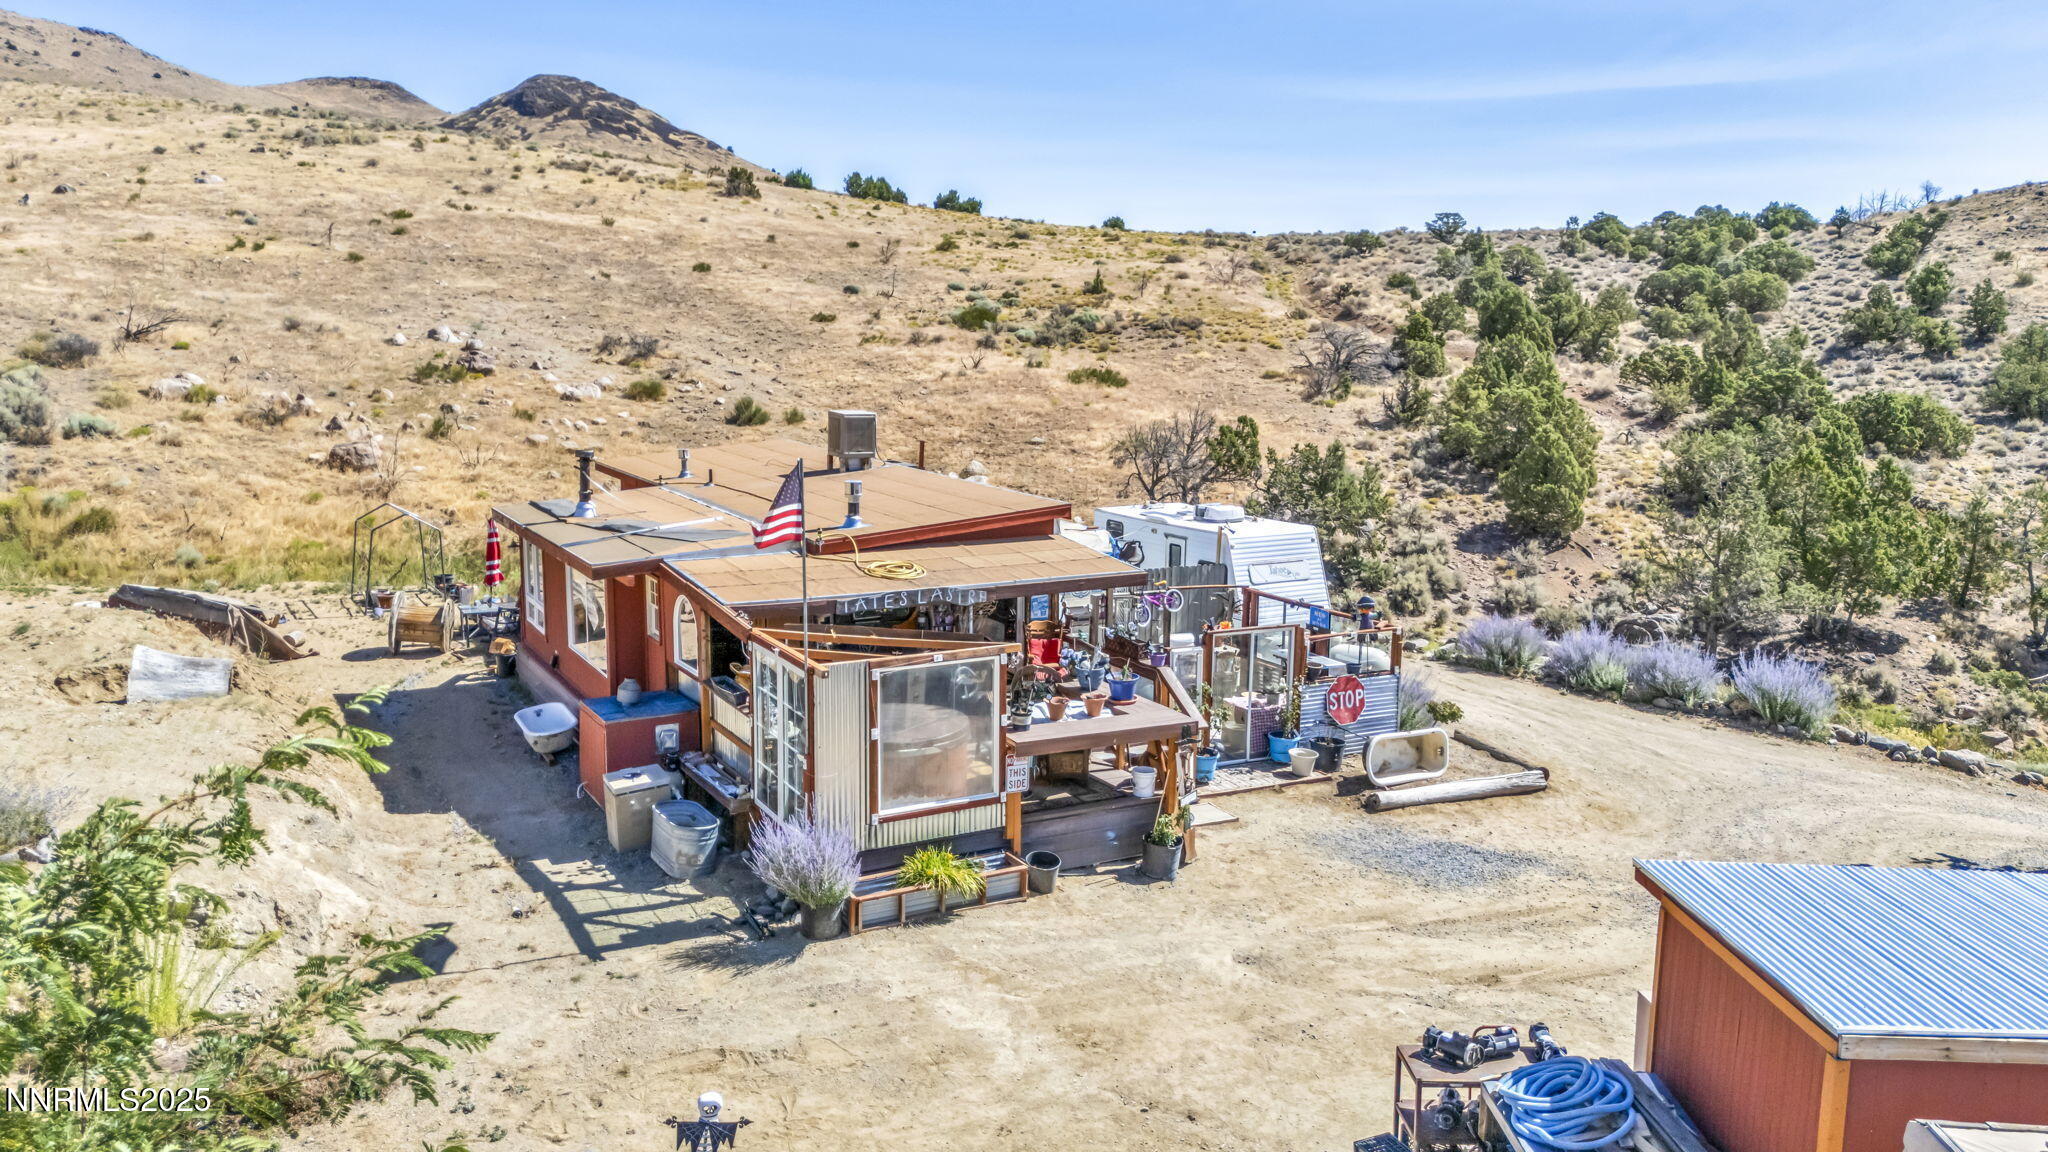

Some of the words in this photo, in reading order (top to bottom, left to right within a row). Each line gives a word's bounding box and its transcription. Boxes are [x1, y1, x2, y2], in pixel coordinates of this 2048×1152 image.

[1329, 688, 1364, 711] STOP
[1008, 767, 1027, 778] THIS
[1008, 778, 1026, 790] SIDE
